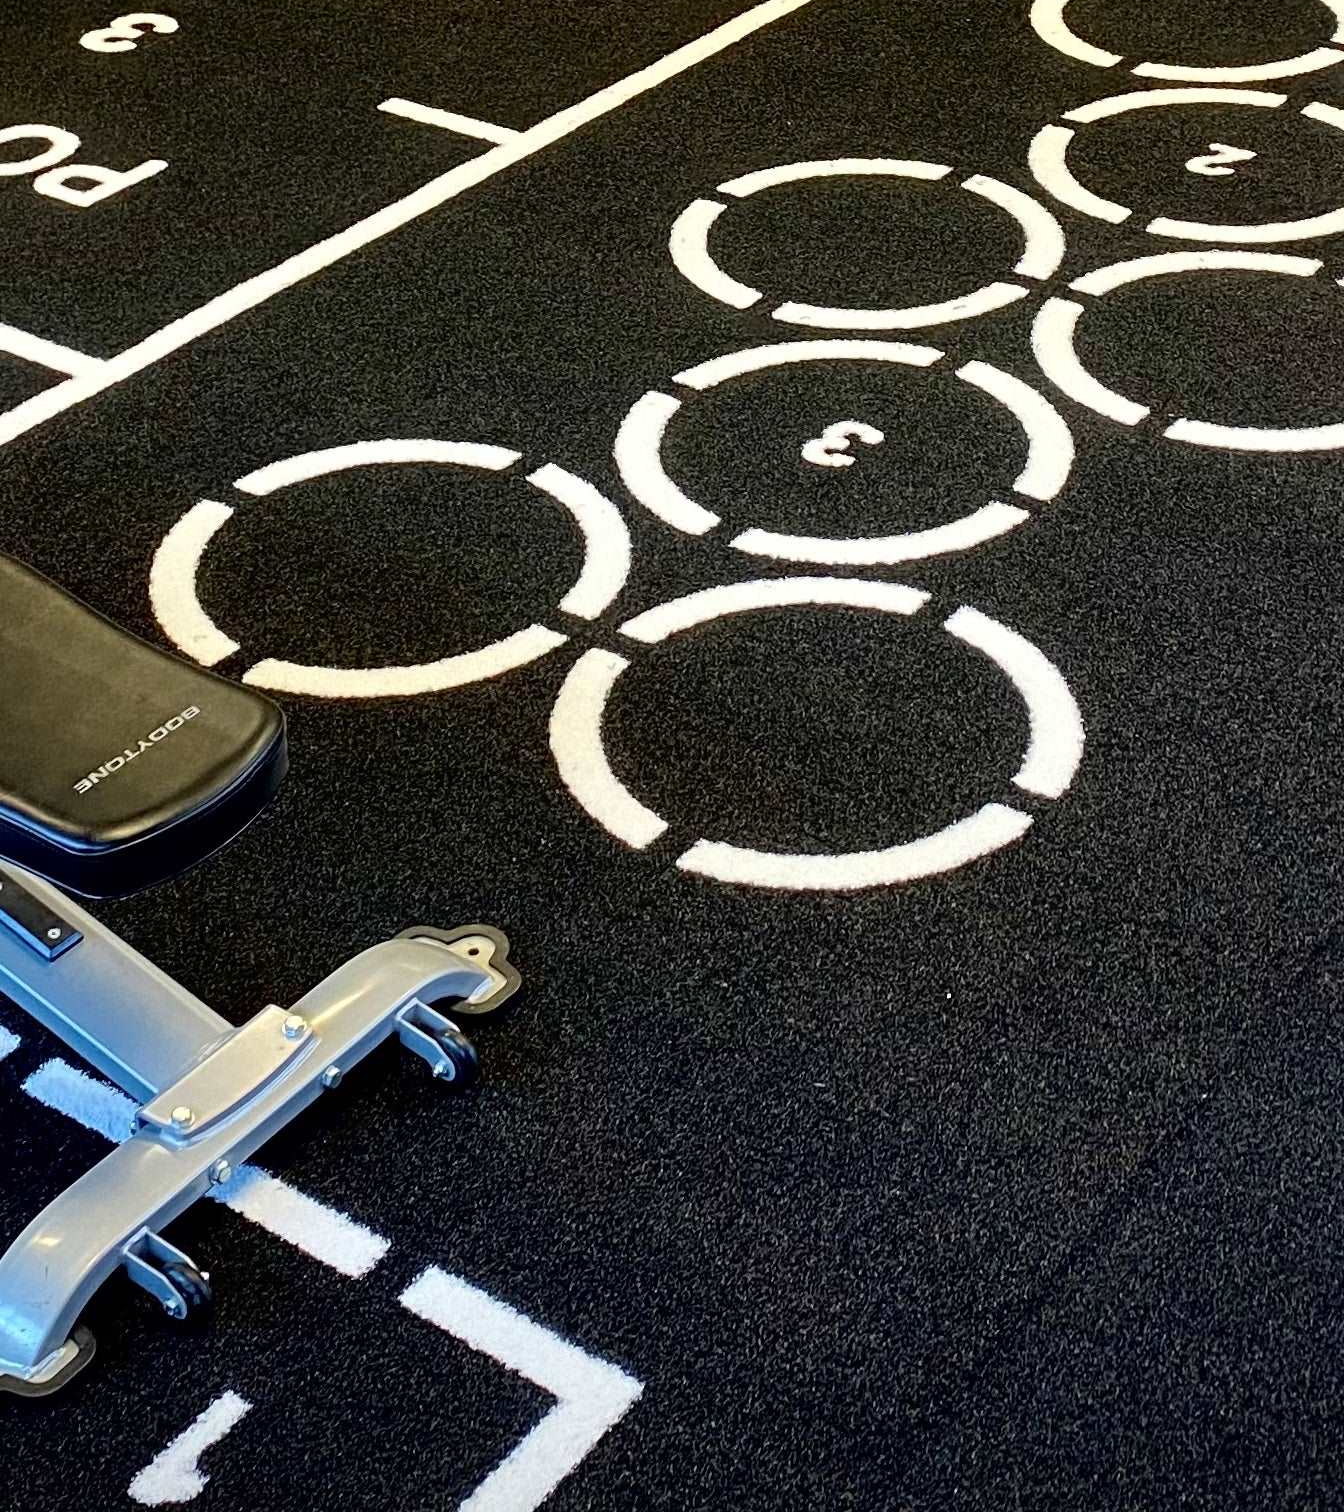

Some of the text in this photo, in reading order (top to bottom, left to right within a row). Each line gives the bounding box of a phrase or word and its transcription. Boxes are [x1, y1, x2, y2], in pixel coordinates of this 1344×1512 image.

[78, 12, 180, 54] 3
[1185, 142, 1257, 177] 2
[800, 418, 885, 468] 3
[72, 704, 201, 795] BODYTONE
[127, 1389, 253, 1506] 1
